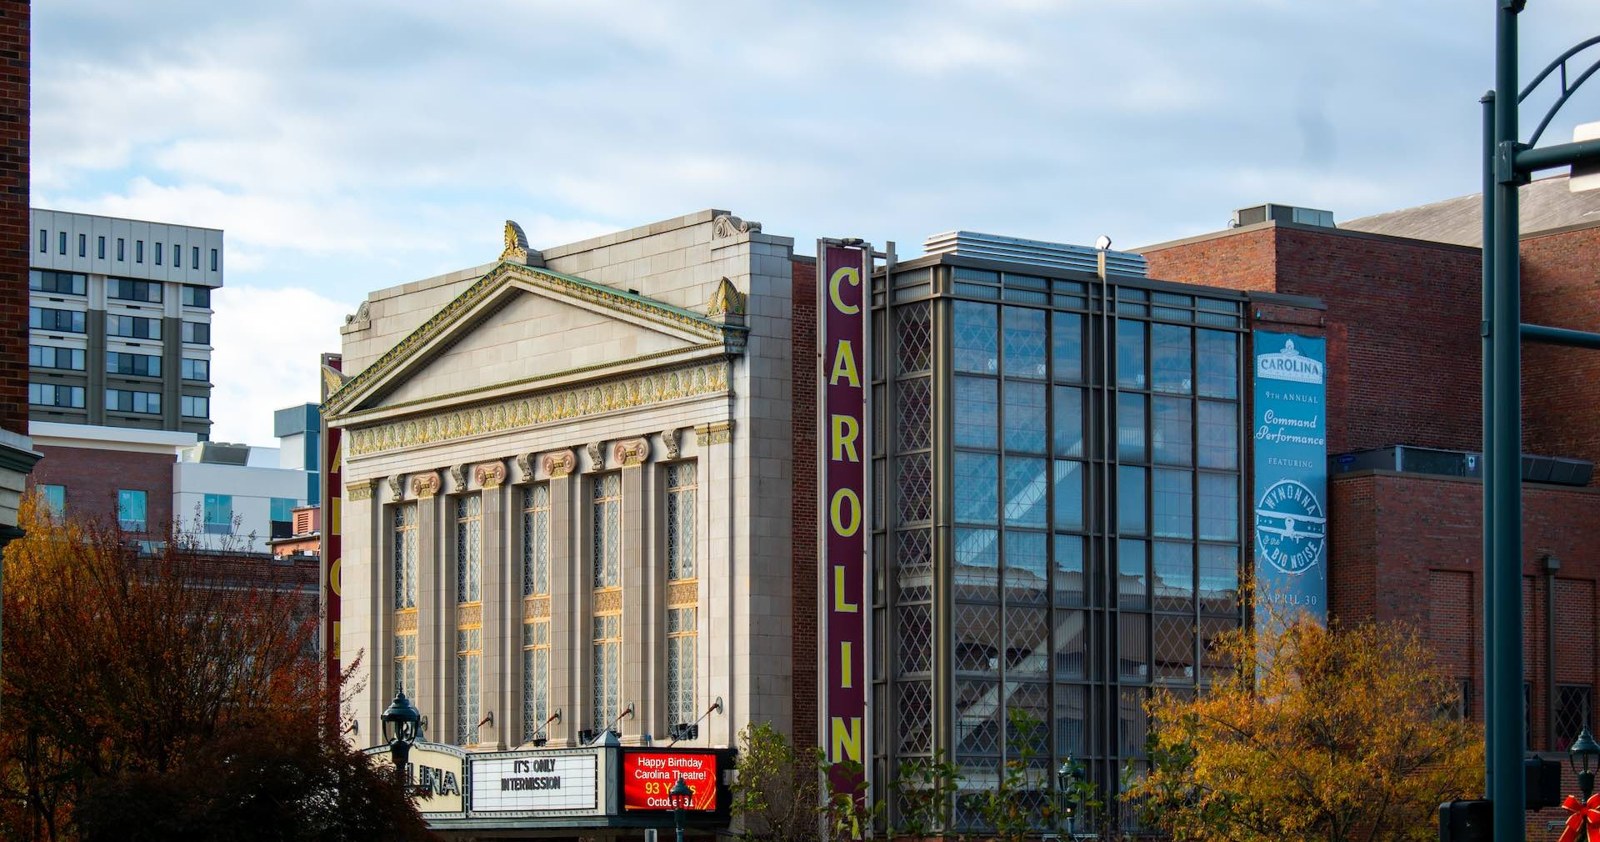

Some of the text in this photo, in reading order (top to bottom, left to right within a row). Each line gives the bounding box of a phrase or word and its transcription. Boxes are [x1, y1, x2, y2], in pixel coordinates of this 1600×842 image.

[1261, 358, 1319, 375] CAROLINA
[1265, 391, 1319, 404] 9TH ANNUAL
[1264, 409, 1318, 428] Command
[1256, 425, 1325, 445] Performance
[1268, 457, 1313, 468] FEATURING
[1265, 485, 1317, 515] WYNONNA
[1291, 541, 1318, 569] NOISE
[1305, 595, 1317, 605] 30
[514, 759, 556, 774] IT'S ONLY
[638, 757, 703, 769] Happy Birthday
[635, 769, 707, 780] Carolina Theatre!
[501, 776, 561, 791] INTERMISSION
[645, 782, 660, 795] 93
[647, 797, 681, 807] Octobe
